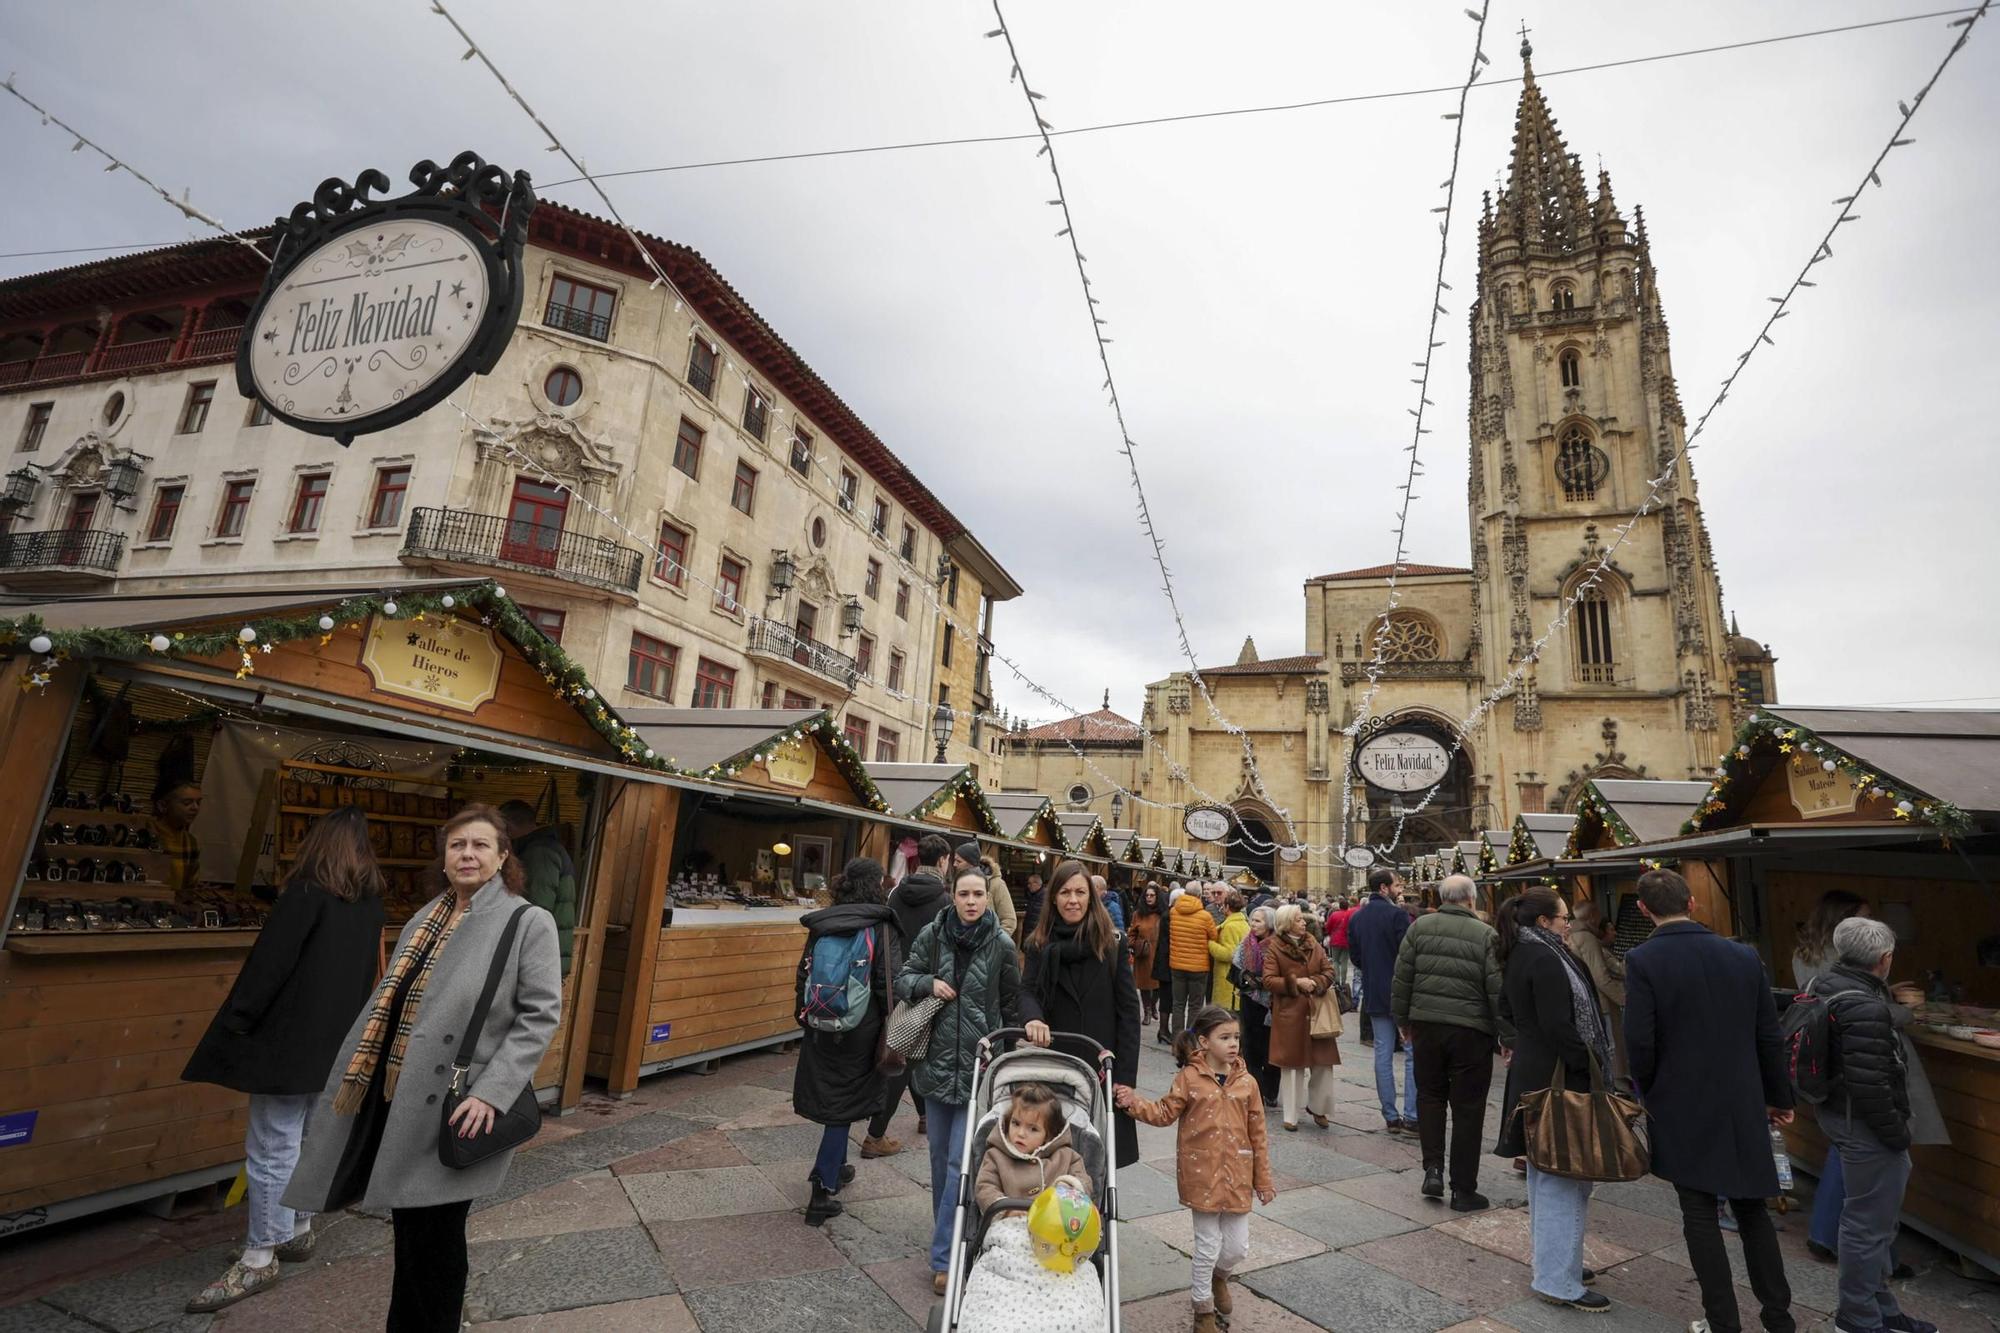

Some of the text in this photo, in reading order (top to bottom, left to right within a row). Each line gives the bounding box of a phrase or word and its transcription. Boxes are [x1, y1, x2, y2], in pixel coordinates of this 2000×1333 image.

[287, 280, 442, 357] Feliz Navidad
[411, 634, 471, 664] aller de
[412, 654, 460, 680] Hieros
[1375, 753, 1432, 771] Feliz Navidad
